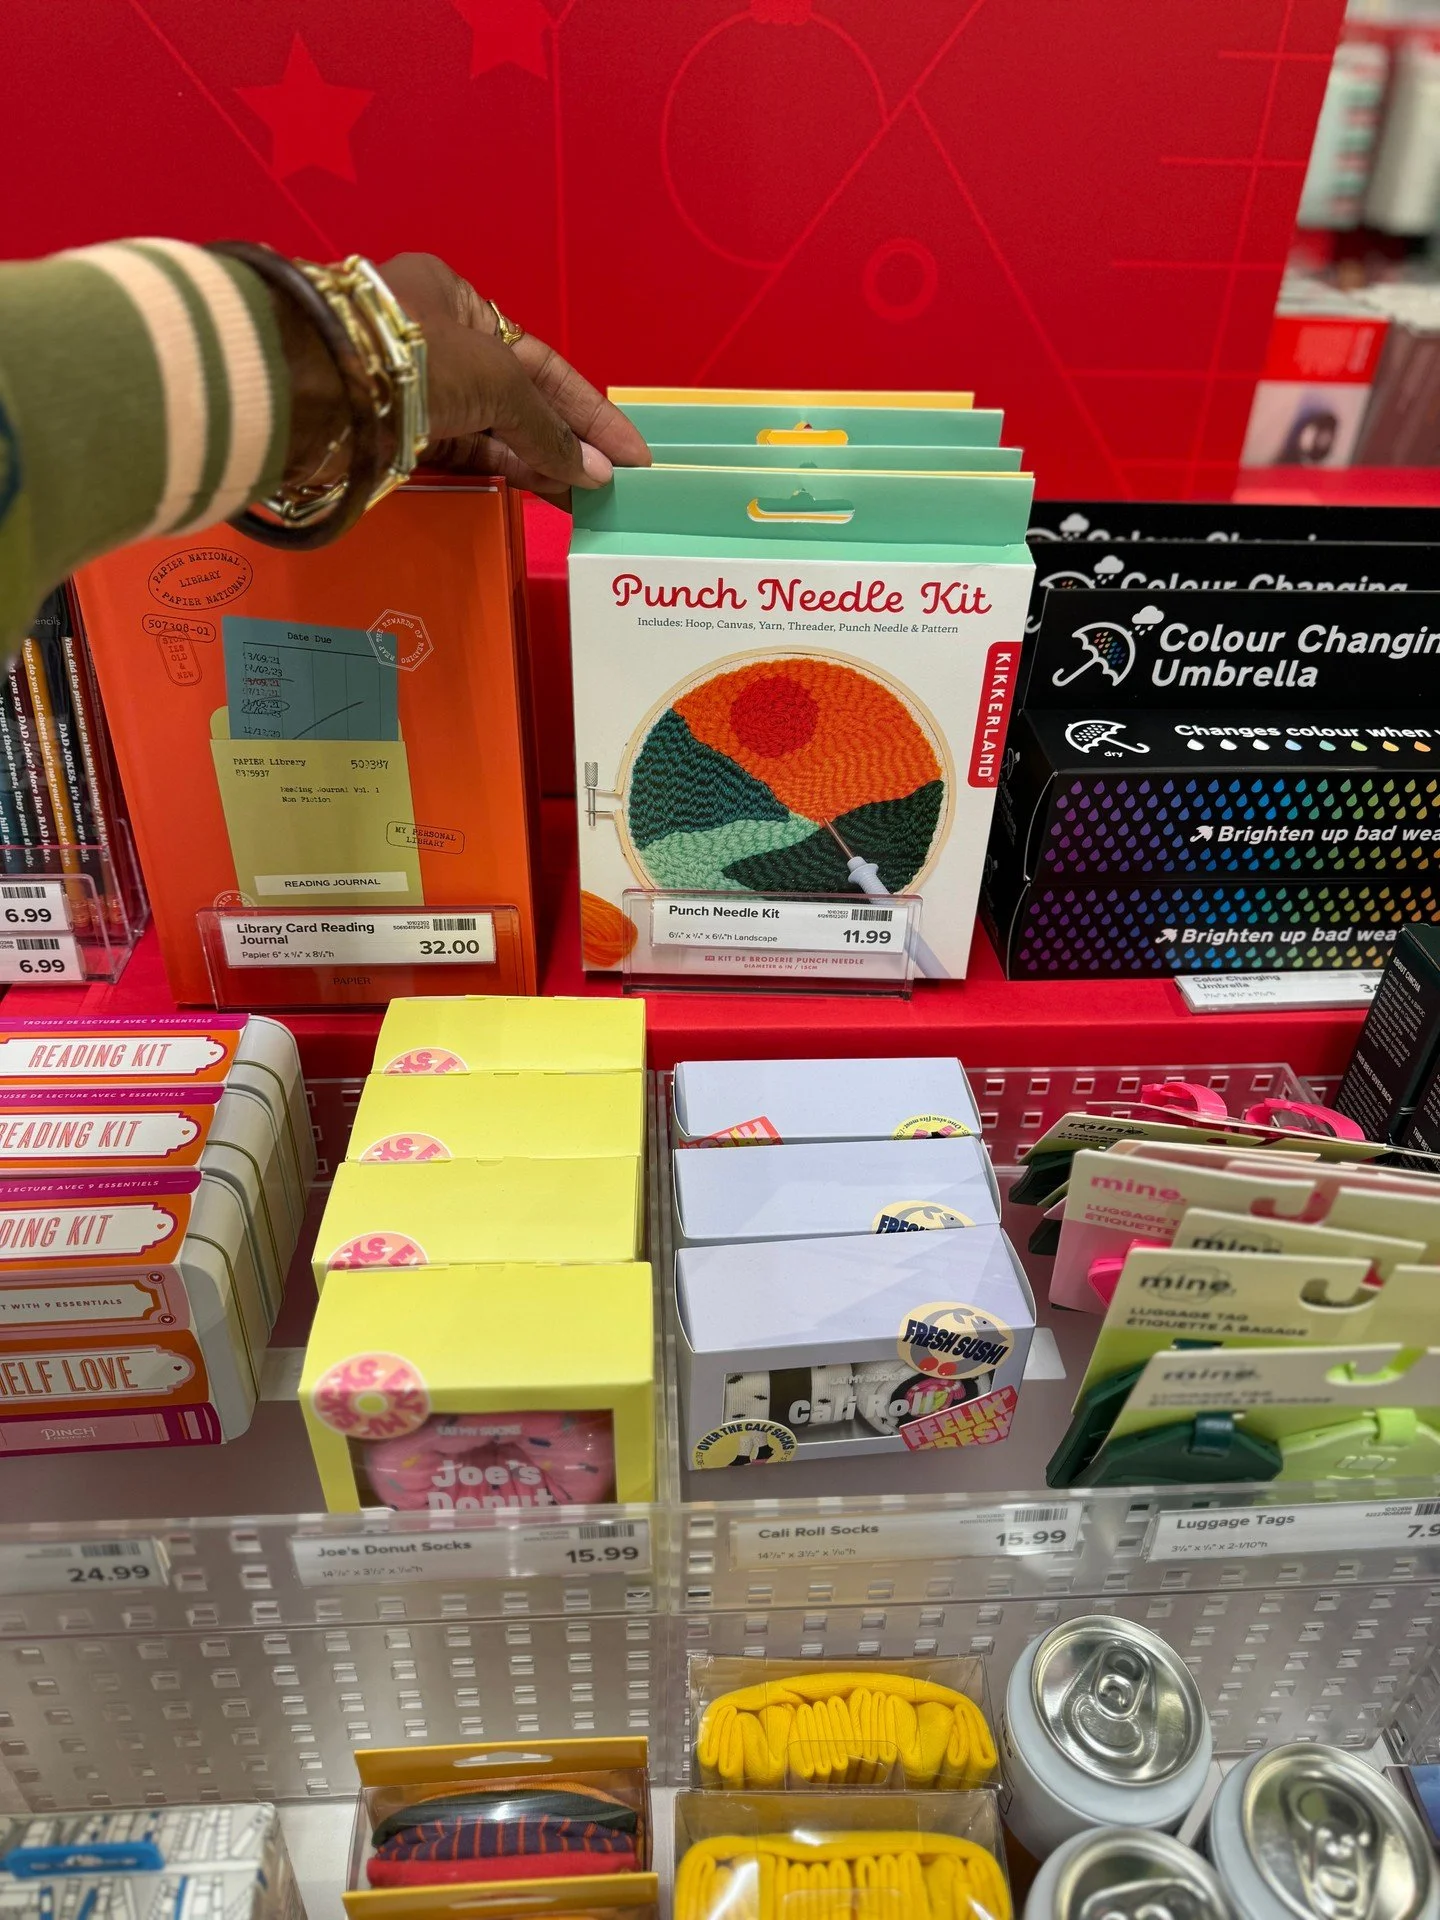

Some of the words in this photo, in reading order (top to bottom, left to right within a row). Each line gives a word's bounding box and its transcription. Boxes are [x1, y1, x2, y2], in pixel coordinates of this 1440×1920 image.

[153, 557, 186, 584] PAPIER
[188, 551, 241, 567] NATIONAL
[179, 570, 221, 588] LIBRARY
[162, 591, 202, 606] PAPIER
[206, 574, 247, 604] NATIONAL
[612, 573, 747, 609] Punch
[758, 578, 905, 614] Needle
[920, 581, 993, 615] Kit
[148, 619, 211, 636] 507308-01
[638, 616, 682, 629] Includes:
[685, 618, 715, 631] Hoop,
[717, 620, 756, 631] Canvas,
[759, 621, 785, 632] Yarn,
[787, 621, 836, 633] Threader,
[839, 622, 870, 633] Punch
[873, 623, 908, 633] Needle
[911, 624, 918, 633] &
[921, 624, 959, 634] Pattern
[287, 631, 310, 643] Date
[314, 634, 332, 644] Due
[1160, 623, 1286, 653] Colour
[24, 638, 34, 663] What
[69, 658, 79, 674] did
[1151, 659, 1319, 688] Umbrella
[9, 674, 19, 694] you
[30, 676, 40, 693] you
[72, 674, 81, 690] the
[14, 696, 22, 713] say
[34, 695, 45, 711] call
[73, 690, 84, 716] pirate
[977, 652, 1013, 777] KIKKERLAND
[18, 715, 29, 738] DAD
[38, 712, 49, 741] cheese
[59, 723, 70, 746] DAD
[1174, 724, 1281, 738] Changes
[1285, 727, 1360, 738] colour
[1365, 730, 1431, 738] when
[3, 735, 13, 761] those
[23, 740, 36, 769] Joke?
[43, 742, 55, 766] that's
[83, 743, 93, 759] his
[1104, 751, 1123, 759] dry
[64, 748, 77, 784] JOKES,
[233, 758, 265, 767] PAPIER
[269, 758, 307, 768] Library
[9, 763, 18, 789] trees,
[29, 770, 39, 794] More
[48, 767, 57, 783] not
[14, 791, 25, 812] they
[51, 783, 63, 811] yours?
[70, 786, 79, 801] it's
[34, 796, 44, 815] like
[73, 802, 83, 824] how
[19, 813, 29, 836] seem
[38, 816, 50, 838] RAD
[57, 812, 68, 837] nacho
[77, 824, 87, 841] eye
[395, 826, 407, 834] MY
[412, 828, 457, 841] PERSONAL
[406, 836, 445, 848] LIBRARY
[1217, 825, 1315, 845] Brighten
[1320, 829, 1348, 844] up
[1354, 825, 1398, 842] bad
[285, 879, 331, 888] READING
[333, 877, 381, 887] JOURNAL
[5, 908, 52, 923] 6.99
[669, 905, 710, 917] Punch
[713, 906, 759, 918] Needle
[762, 909, 780, 919] Kit
[237, 923, 282, 938] Library
[286, 922, 319, 934] Card
[321, 921, 375, 936] Reading
[735, 934, 778, 943] Landscape
[843, 930, 892, 944] 11.99
[1181, 928, 1275, 945] Brighten
[1280, 931, 1307, 945] up
[1312, 927, 1353, 942] bad
[240, 934, 289, 945] Journal
[419, 940, 480, 955] 32.00
[242, 951, 270, 960] Papier
[718, 955, 733, 963] KIT
[749, 956, 794, 964] BRODERIE
[796, 957, 830, 965] PUNCH
[19, 959, 65, 973] 6.99
[333, 976, 372, 985] PAPIER
[1226, 974, 1281, 982] Changing
[159, 1017, 213, 1025] ESSENTIELS
[27, 1043, 128, 1068] READING
[131, 1042, 173, 1067] KIT
[30, 1092, 43, 1100] DE
[91, 1091, 118, 1099] AVEC
[129, 1090, 186, 1098] ESSENTIELS
[98, 1120, 142, 1148] KIT
[7, 1184, 53, 1193] LECTURE
[56, 1183, 84, 1191] AVEC
[98, 1180, 160, 1189] ESSENTIELS
[1089, 1175, 1187, 1207] mine.
[1086, 1203, 1169, 1225] LUGGAGE
[66, 1214, 113, 1247] KIT
[11, 1302, 40, 1310] WITH
[56, 1298, 123, 1308] ESSENTIALS
[1130, 1307, 1212, 1321] LUGGAGE
[1217, 1312, 1249, 1322] TAG
[1238, 1323, 1310, 1337] BAGAGE
[902, 1318, 958, 1357] FRESH
[954, 1335, 1010, 1366] SUSHI
[61, 1356, 139, 1392] LOVE
[788, 1394, 857, 1426] Cali
[869, 1391, 937, 1420] Roll
[41, 1425, 97, 1441] PINCH
[697, 1431, 722, 1451] OVER
[719, 1423, 743, 1436] THE
[745, 1422, 775, 1433] CALF
[771, 1428, 795, 1451] SOCKS
[431, 1459, 542, 1487] Joe's
[1177, 1516, 1250, 1530] Luggage
[1256, 1514, 1296, 1527] Tags
[759, 1529, 790, 1539] Cali
[795, 1526, 826, 1538] Roll
[831, 1524, 880, 1536] Socks
[996, 1530, 1068, 1547] 15.99
[317, 1545, 360, 1558] Joe's
[365, 1543, 418, 1555] Donut
[422, 1540, 472, 1552] Socks
[564, 1546, 640, 1563] 15.99
[67, 1564, 150, 1583] 24.99
